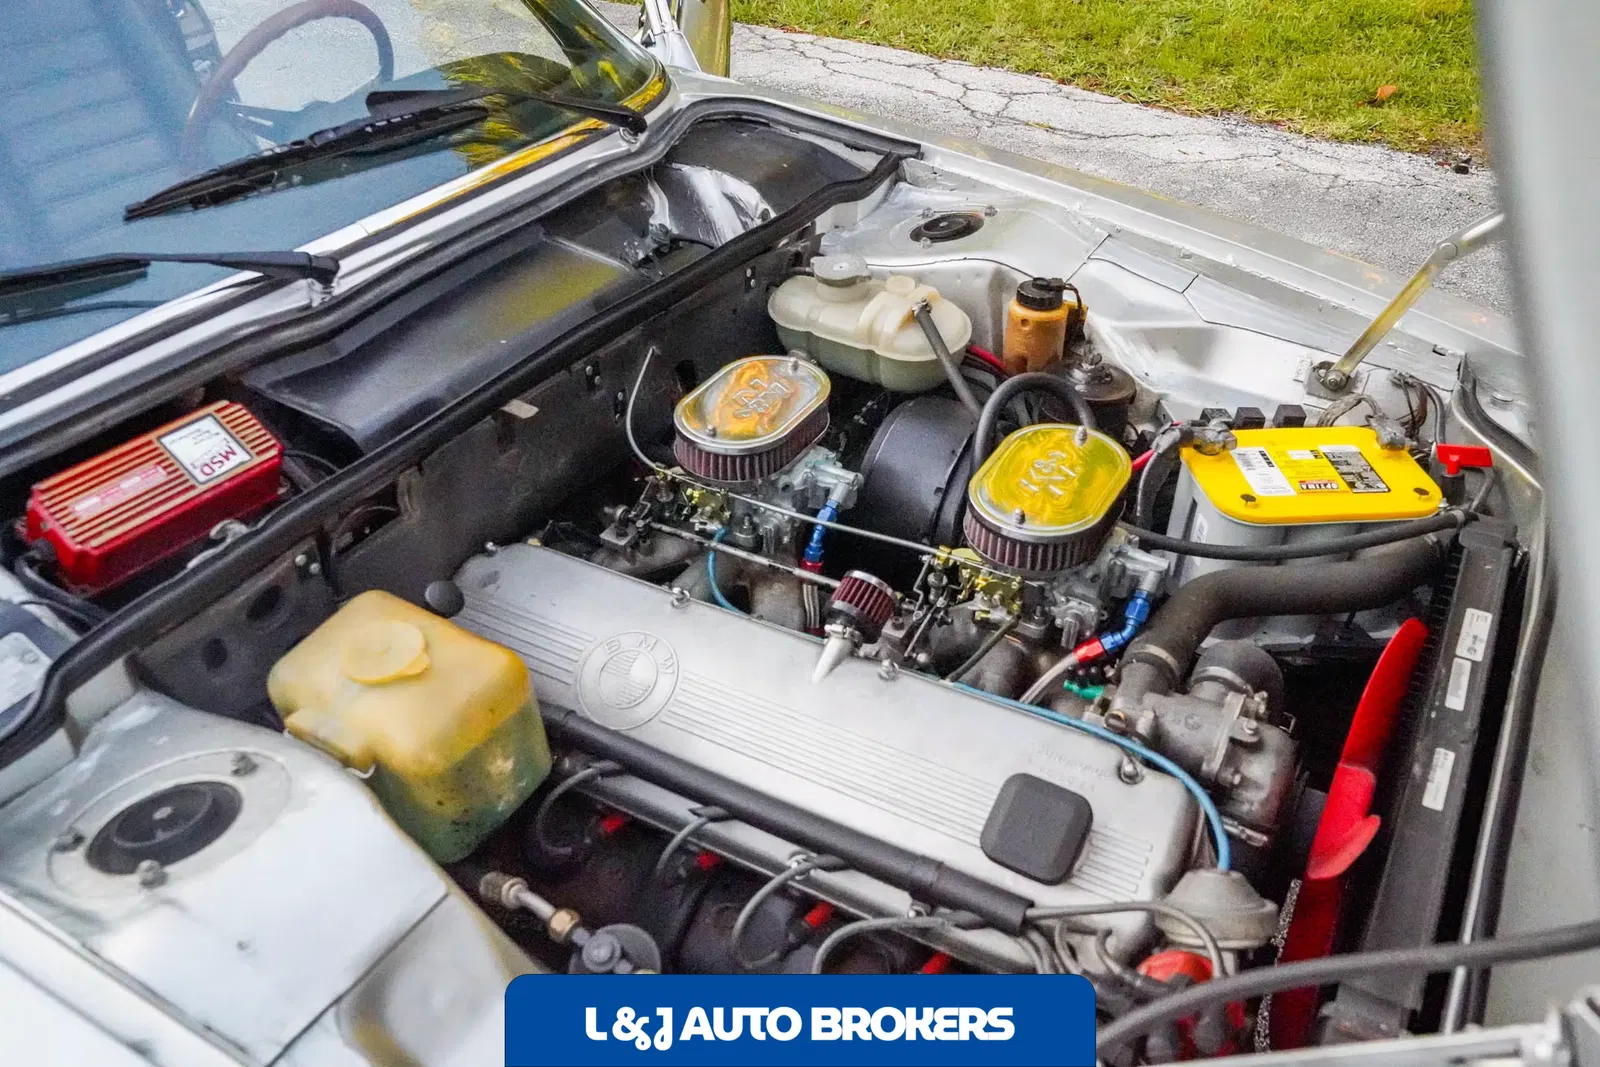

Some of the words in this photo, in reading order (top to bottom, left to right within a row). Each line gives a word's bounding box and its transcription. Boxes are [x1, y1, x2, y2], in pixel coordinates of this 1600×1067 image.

[200, 444, 238, 477] MSD
[1300, 482, 1339, 491] OPTIMA
[604, 634, 676, 675] BMW
